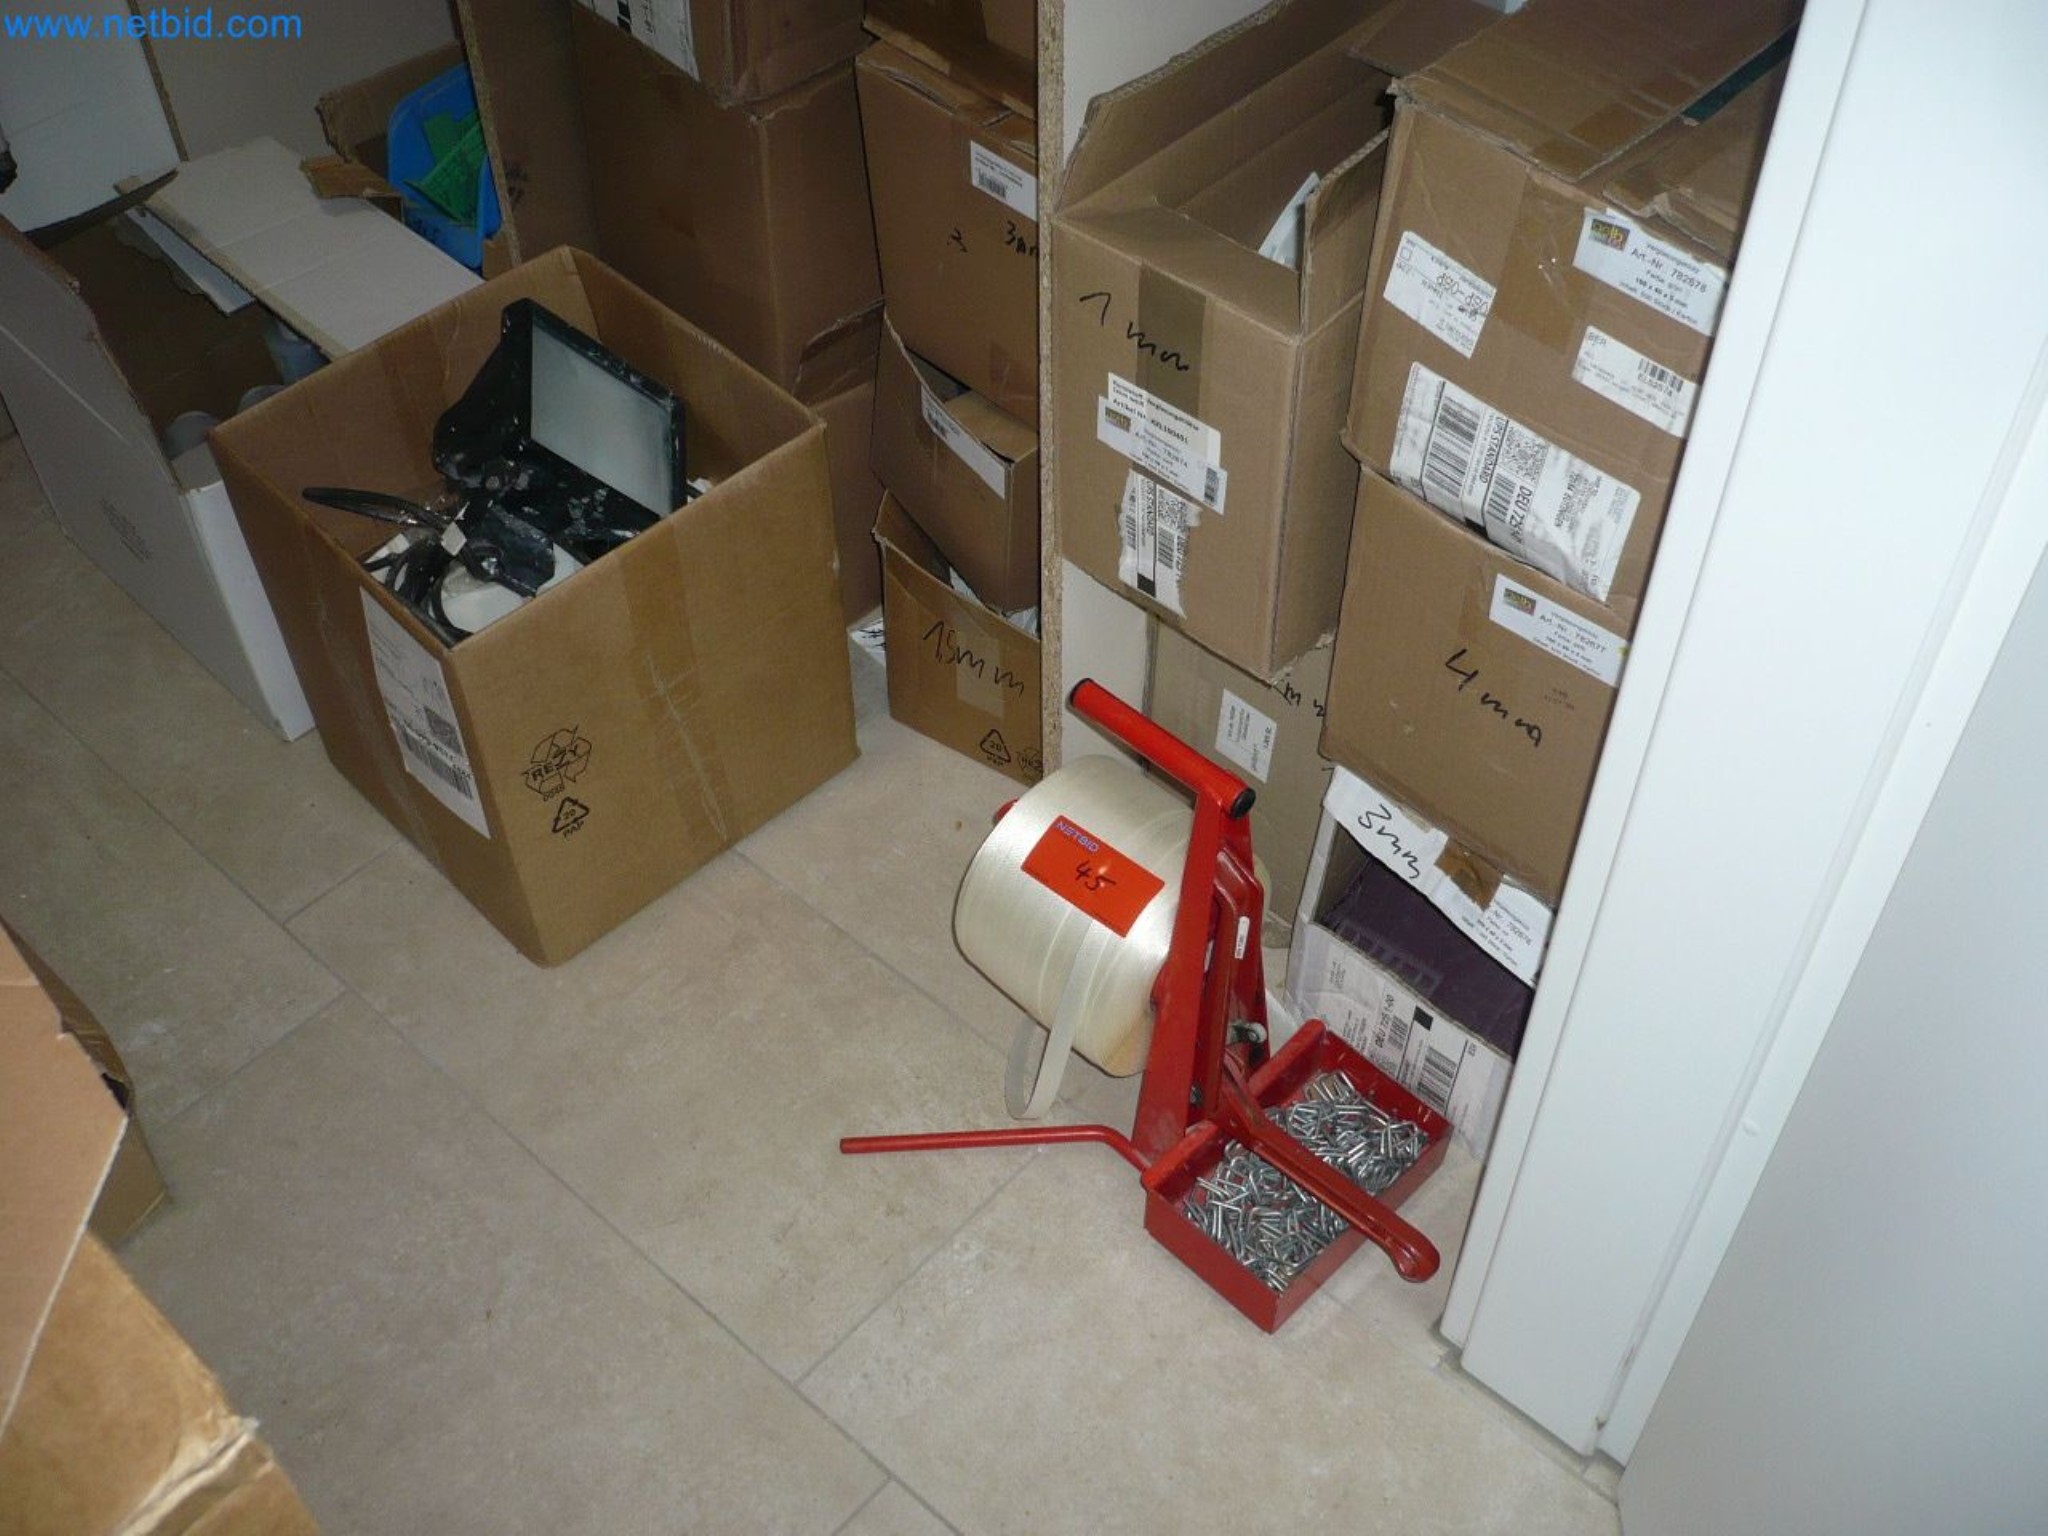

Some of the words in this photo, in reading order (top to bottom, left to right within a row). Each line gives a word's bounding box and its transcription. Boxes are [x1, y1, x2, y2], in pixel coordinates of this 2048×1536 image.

[1479, 435, 1500, 484] STANDARD
[1515, 485, 1533, 513] DEU
[1055, 821, 1100, 853] NETBID
[1358, 804, 1421, 879] 3mm
[1075, 861, 1117, 892] 45
